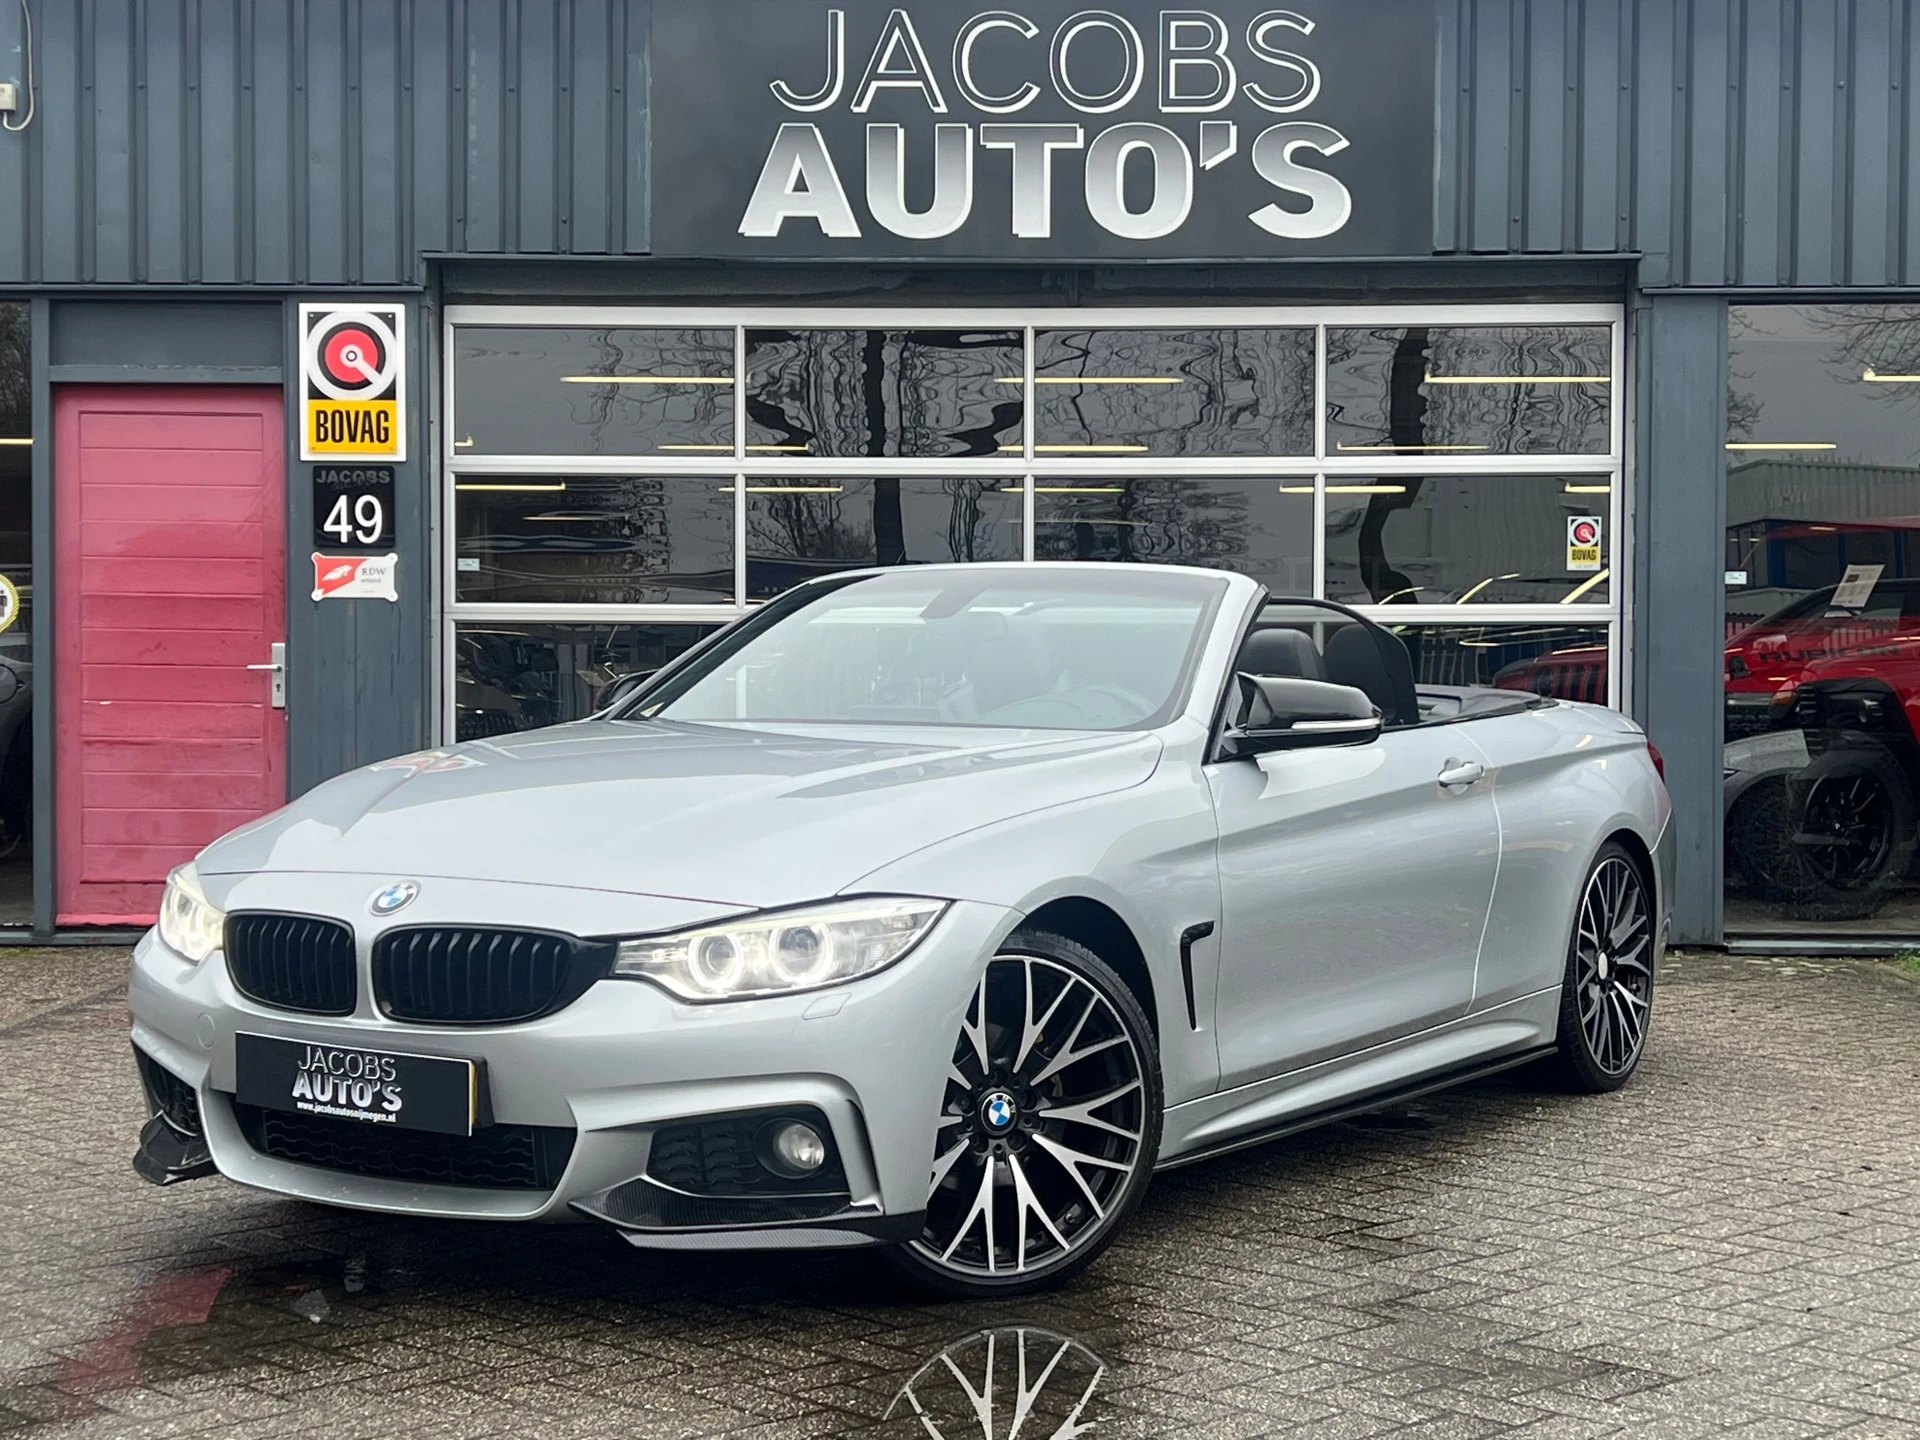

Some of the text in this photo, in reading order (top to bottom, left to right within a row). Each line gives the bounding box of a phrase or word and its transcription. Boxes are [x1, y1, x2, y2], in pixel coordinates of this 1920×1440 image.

[769, 9, 1322, 114] JACOBS
[738, 120, 1353, 240] AUTO'S
[315, 409, 390, 444] BOVAG
[315, 469, 391, 484] JACOBS
[323, 494, 383, 544] 49
[361, 567, 386, 576] RDW
[1571, 549, 1597, 561] BOVAG
[297, 1046, 397, 1081] JACOBS
[292, 1071, 403, 1112] AUTO'S
[296, 1101, 396, 1123] www.jacobsautosnijmegen.nl
